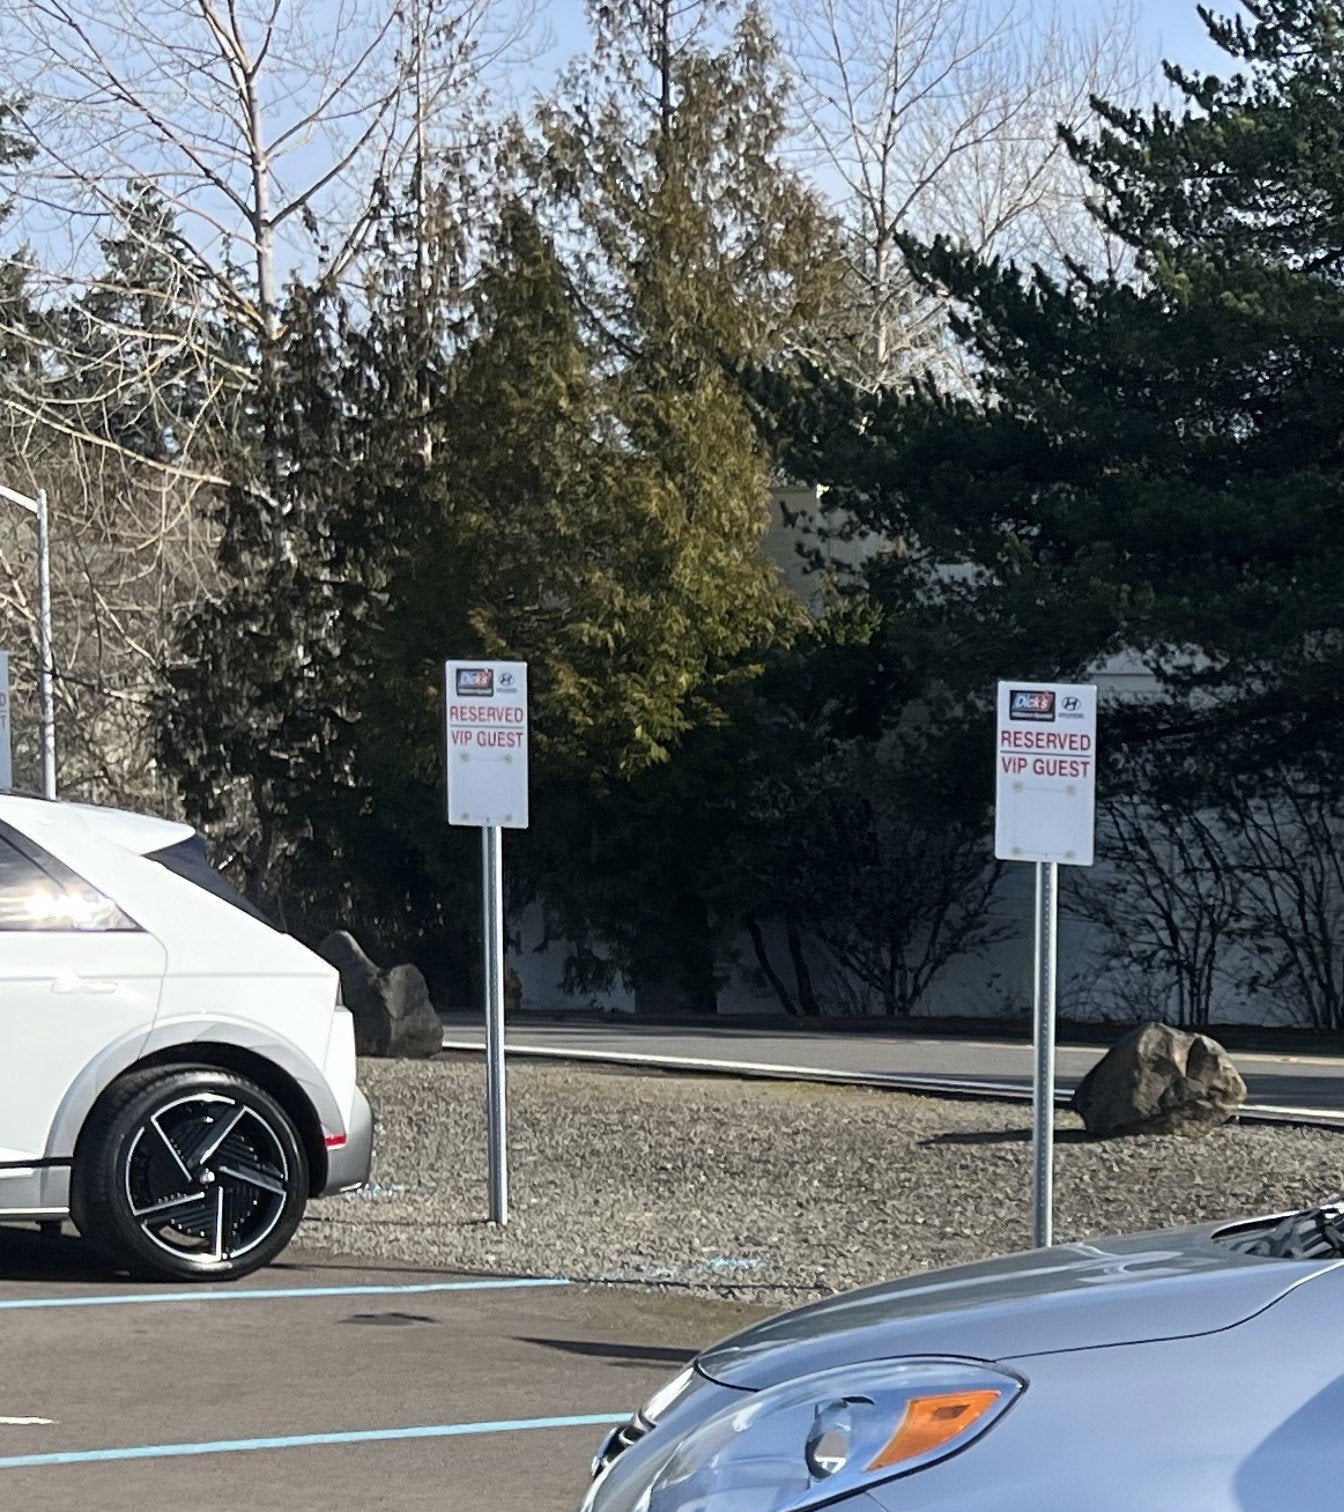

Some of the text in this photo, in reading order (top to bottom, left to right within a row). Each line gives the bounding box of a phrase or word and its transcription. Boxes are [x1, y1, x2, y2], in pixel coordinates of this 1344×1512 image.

[450, 706, 524, 723] RESERVED
[452, 731, 524, 748] VIP GUEST
[1000, 730, 1091, 752] RESERVED
[1002, 756, 1091, 778] VIP GUEST
